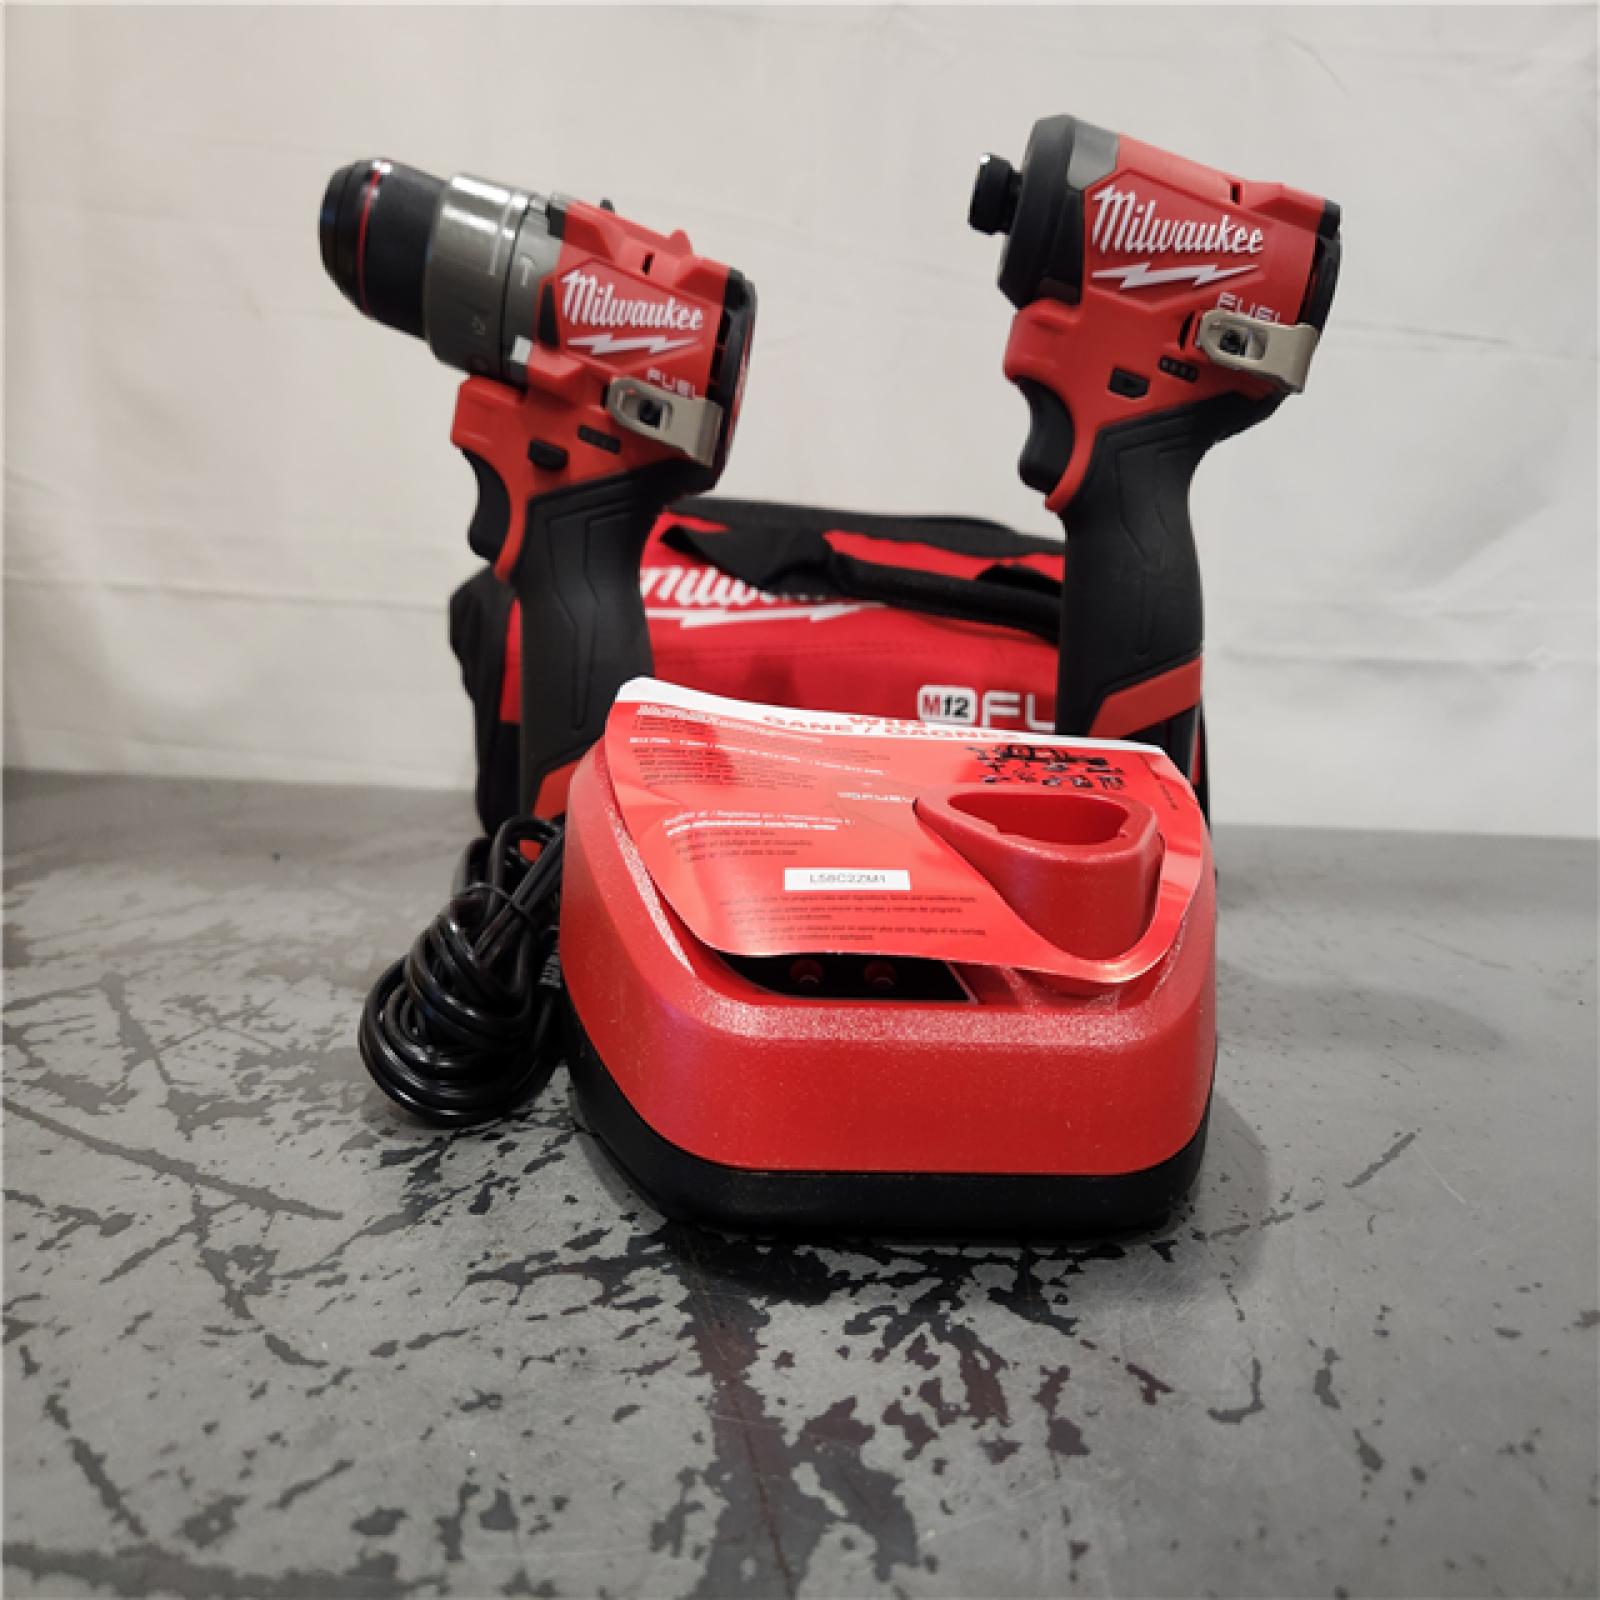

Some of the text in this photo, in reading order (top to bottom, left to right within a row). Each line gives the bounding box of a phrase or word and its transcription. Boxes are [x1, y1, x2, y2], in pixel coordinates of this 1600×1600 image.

[1092, 185, 1264, 253] Milwaukee
[562, 270, 703, 331] Milwaukee
[922, 694, 969, 719] M12
